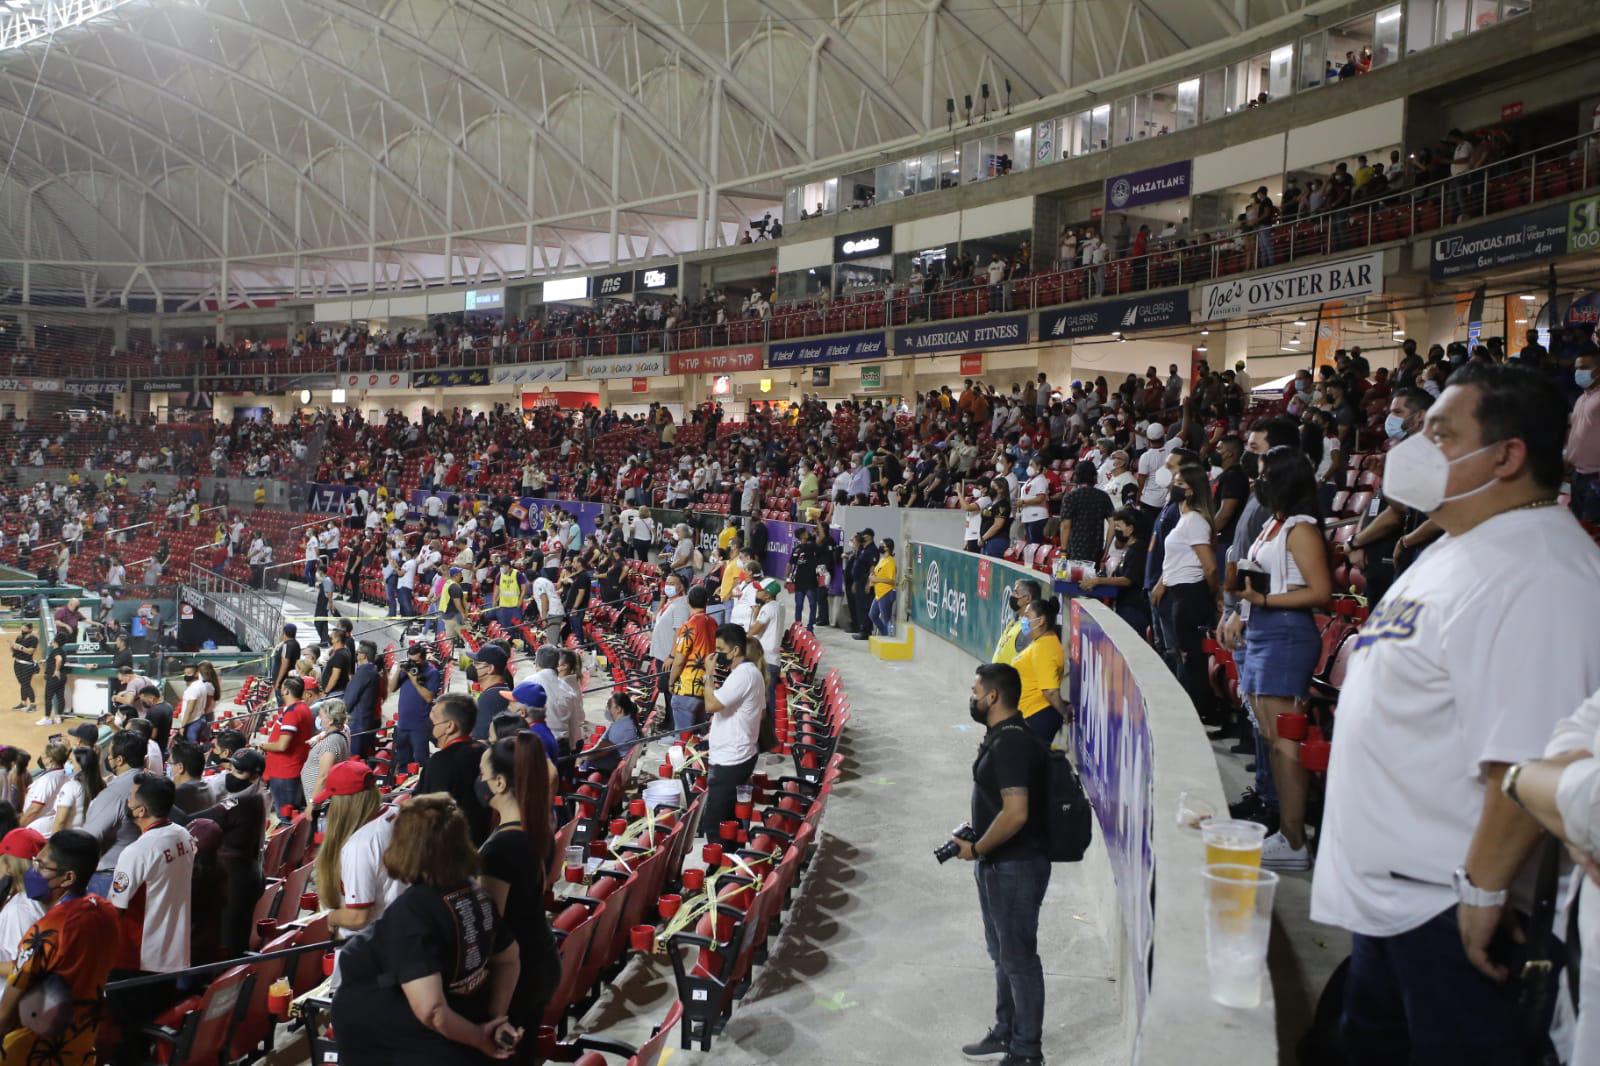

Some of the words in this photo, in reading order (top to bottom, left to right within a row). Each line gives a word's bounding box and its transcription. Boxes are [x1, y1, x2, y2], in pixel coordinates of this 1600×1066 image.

[1208, 281, 1244, 321] Joe's
[1250, 275, 1323, 305] OYSTER
[1329, 263, 1372, 292] BAR
[916, 330, 969, 348] AMERICAN
[974, 324, 1018, 342] FITNESS
[686, 358, 700, 370] TVP
[712, 355, 727, 368] TVP
[737, 353, 754, 366] TVP
